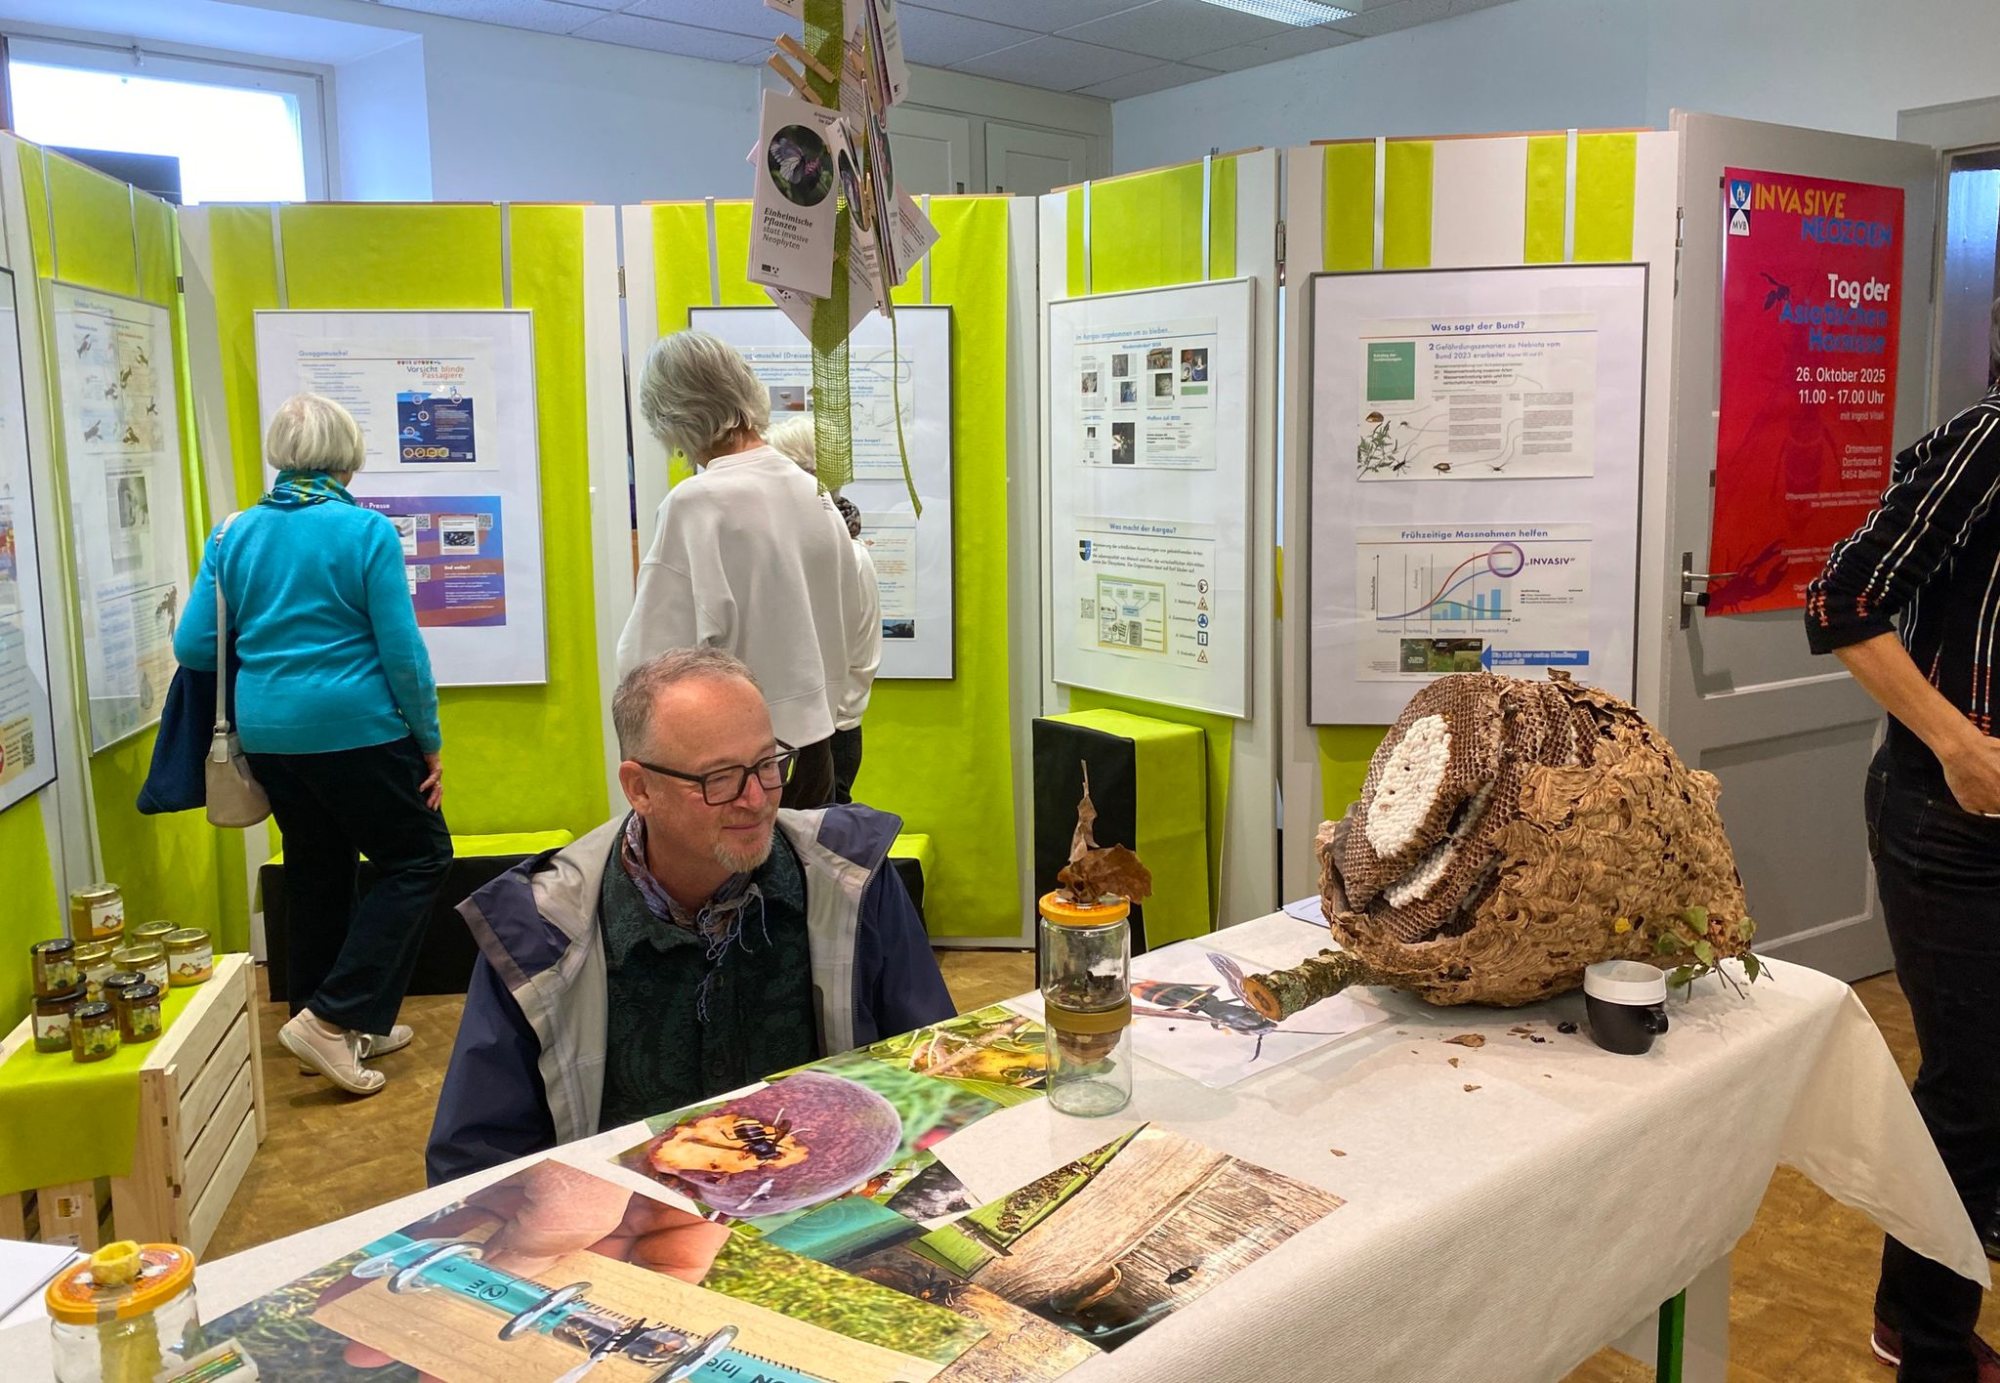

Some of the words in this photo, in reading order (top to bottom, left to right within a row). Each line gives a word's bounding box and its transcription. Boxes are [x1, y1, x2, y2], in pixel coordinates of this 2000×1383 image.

[1755, 183, 1846, 218] INVASIVE
[763, 216, 797, 232] Pflanzen
[764, 207, 813, 228] Einheimische
[1732, 220, 1747, 231] MVB
[763, 226, 780, 236] statt
[781, 230, 809, 244] invasive
[1802, 217, 1892, 248] NEOZOEN
[763, 233, 801, 250] Neophyten
[1828, 273, 1859, 308] Tag
[1863, 276, 1890, 302] der
[1430, 323, 1451, 333] Was
[1453, 323, 1474, 334] sagt
[1477, 322, 1493, 331] der
[1495, 320, 1525, 331] Bund?
[1429, 343, 1434, 351] 2
[1435, 351, 1452, 359] Bund
[406, 365, 438, 373] Vorsicht
[440, 365, 465, 373] blinde
[422, 372, 463, 380] Passagiere
[1796, 366, 1813, 382] 26.
[1816, 367, 1857, 383] Oktober
[1860, 368, 1886, 383] 2025
[1798, 389, 1826, 404] 11.00
[1837, 390, 1864, 404] 17.00
[1867, 390, 1885, 405] Uhr
[1109, 523, 1121, 531] Was
[1122, 524, 1139, 532] macht
[1151, 526, 1176, 535] Aargau?
[1401, 529, 1452, 540] Frühzeitige
[1455, 529, 1517, 538] Massnahmen
[1519, 529, 1548, 538] helfen
